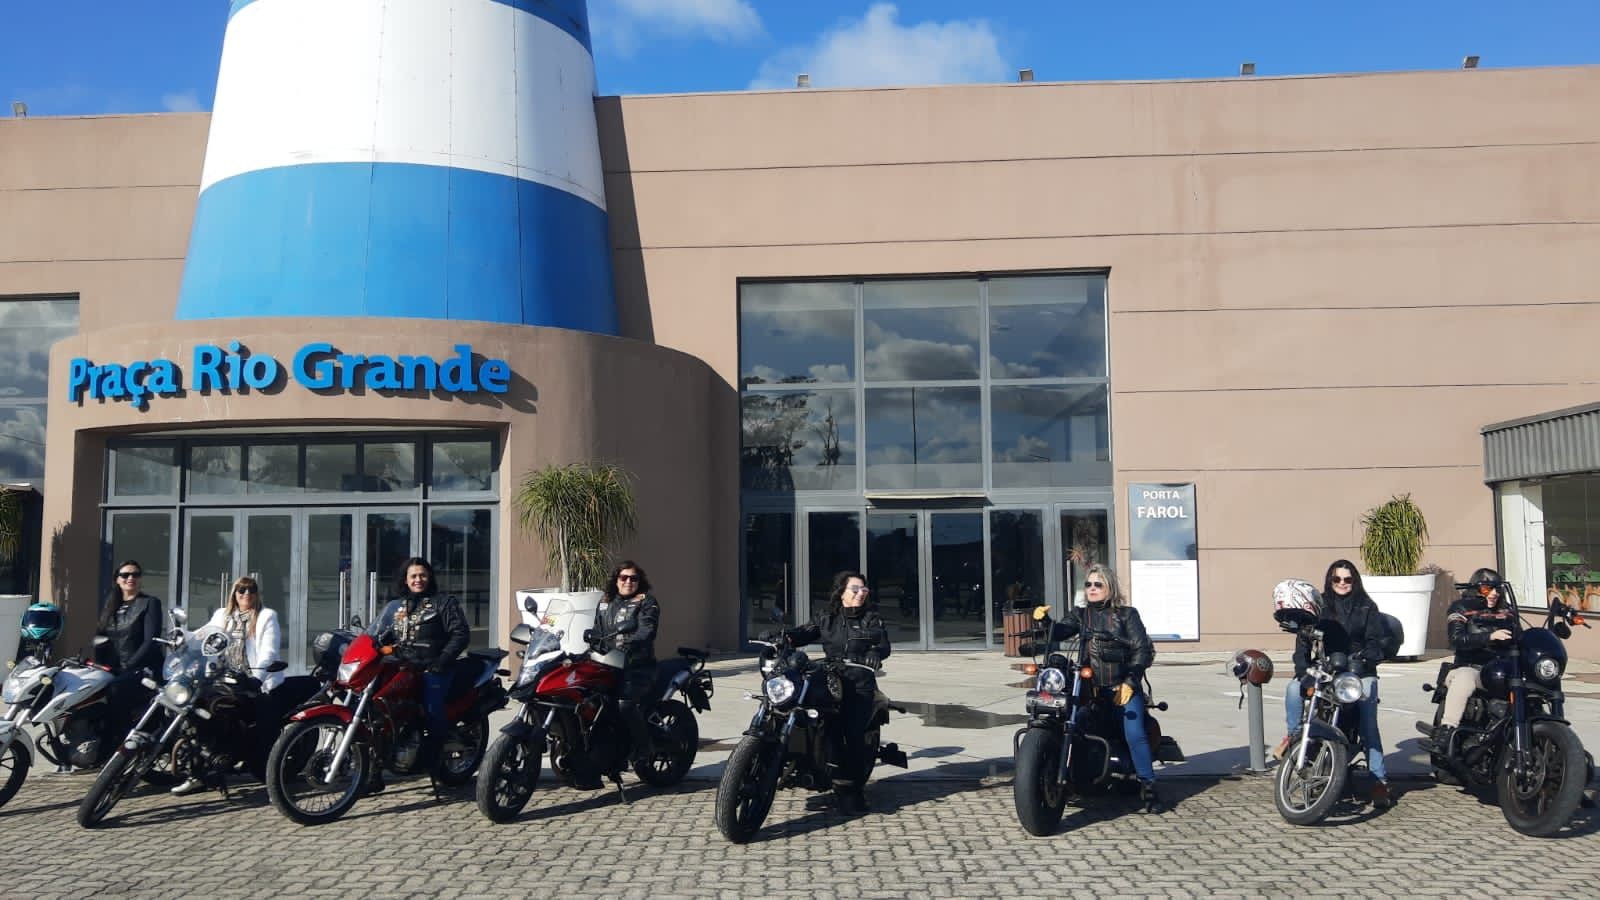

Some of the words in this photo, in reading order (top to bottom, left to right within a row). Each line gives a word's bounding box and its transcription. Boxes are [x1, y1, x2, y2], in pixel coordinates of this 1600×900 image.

[70, 357, 176, 408] Praça
[192, 338, 278, 392] Rio
[292, 342, 511, 393] Grande
[1143, 490, 1181, 500] PORTA
[1137, 506, 1188, 519] FAROL
